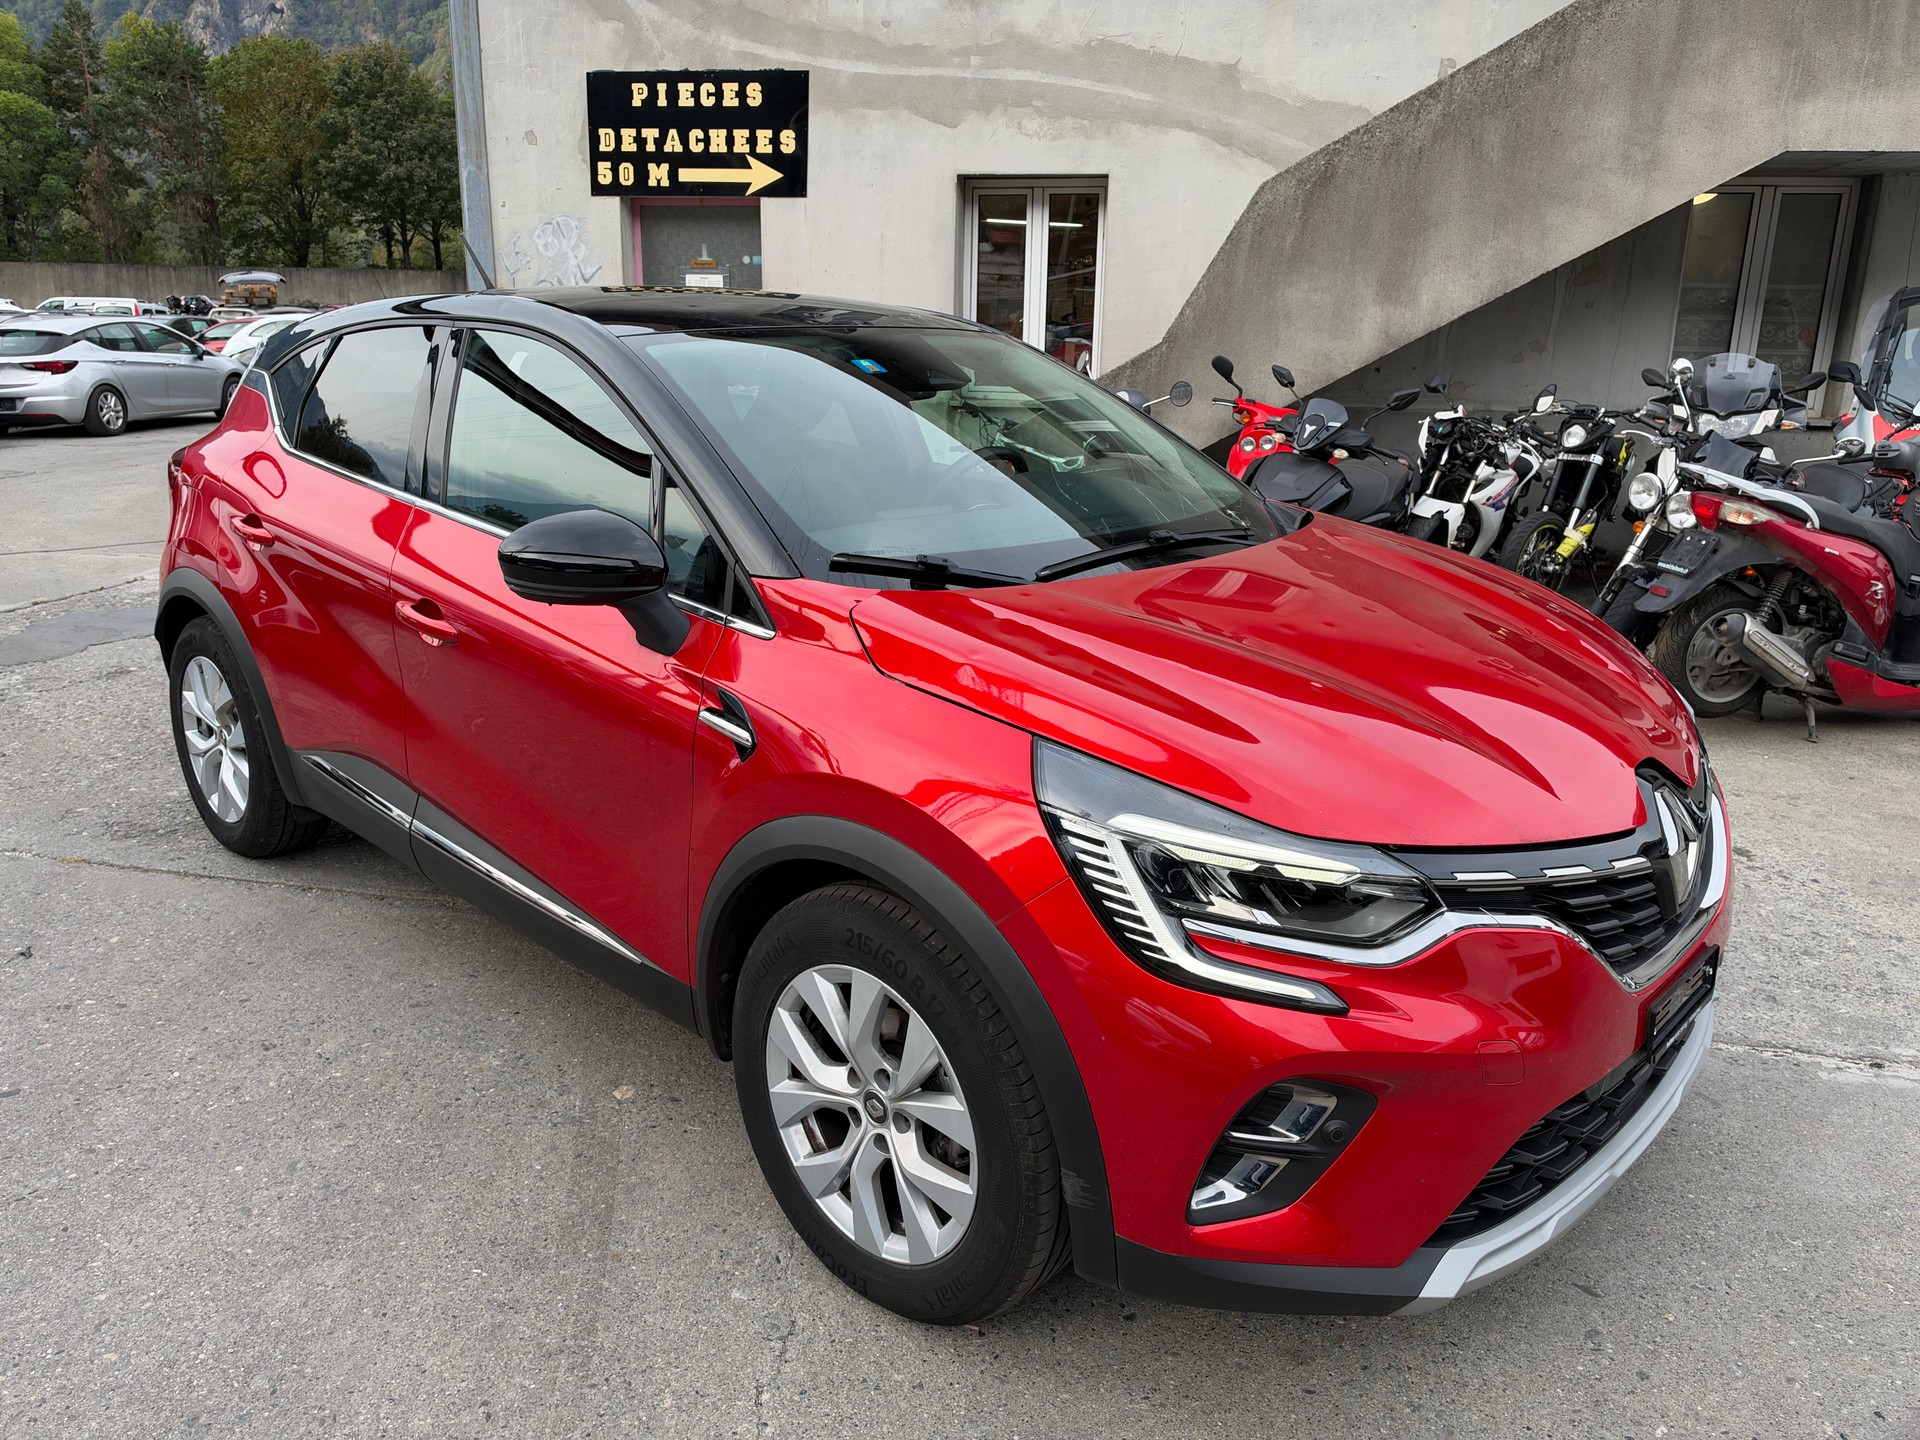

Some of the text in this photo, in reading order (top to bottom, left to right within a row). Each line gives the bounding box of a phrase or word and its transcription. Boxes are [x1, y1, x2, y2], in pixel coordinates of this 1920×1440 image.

[631, 82, 763, 107] PIECES
[598, 127, 796, 153] DETACHEES
[597, 161, 670, 187] 50 M
[844, 927, 908, 980] 215/60
[909, 974, 926, 998] R
[926, 992, 948, 1018] 17
